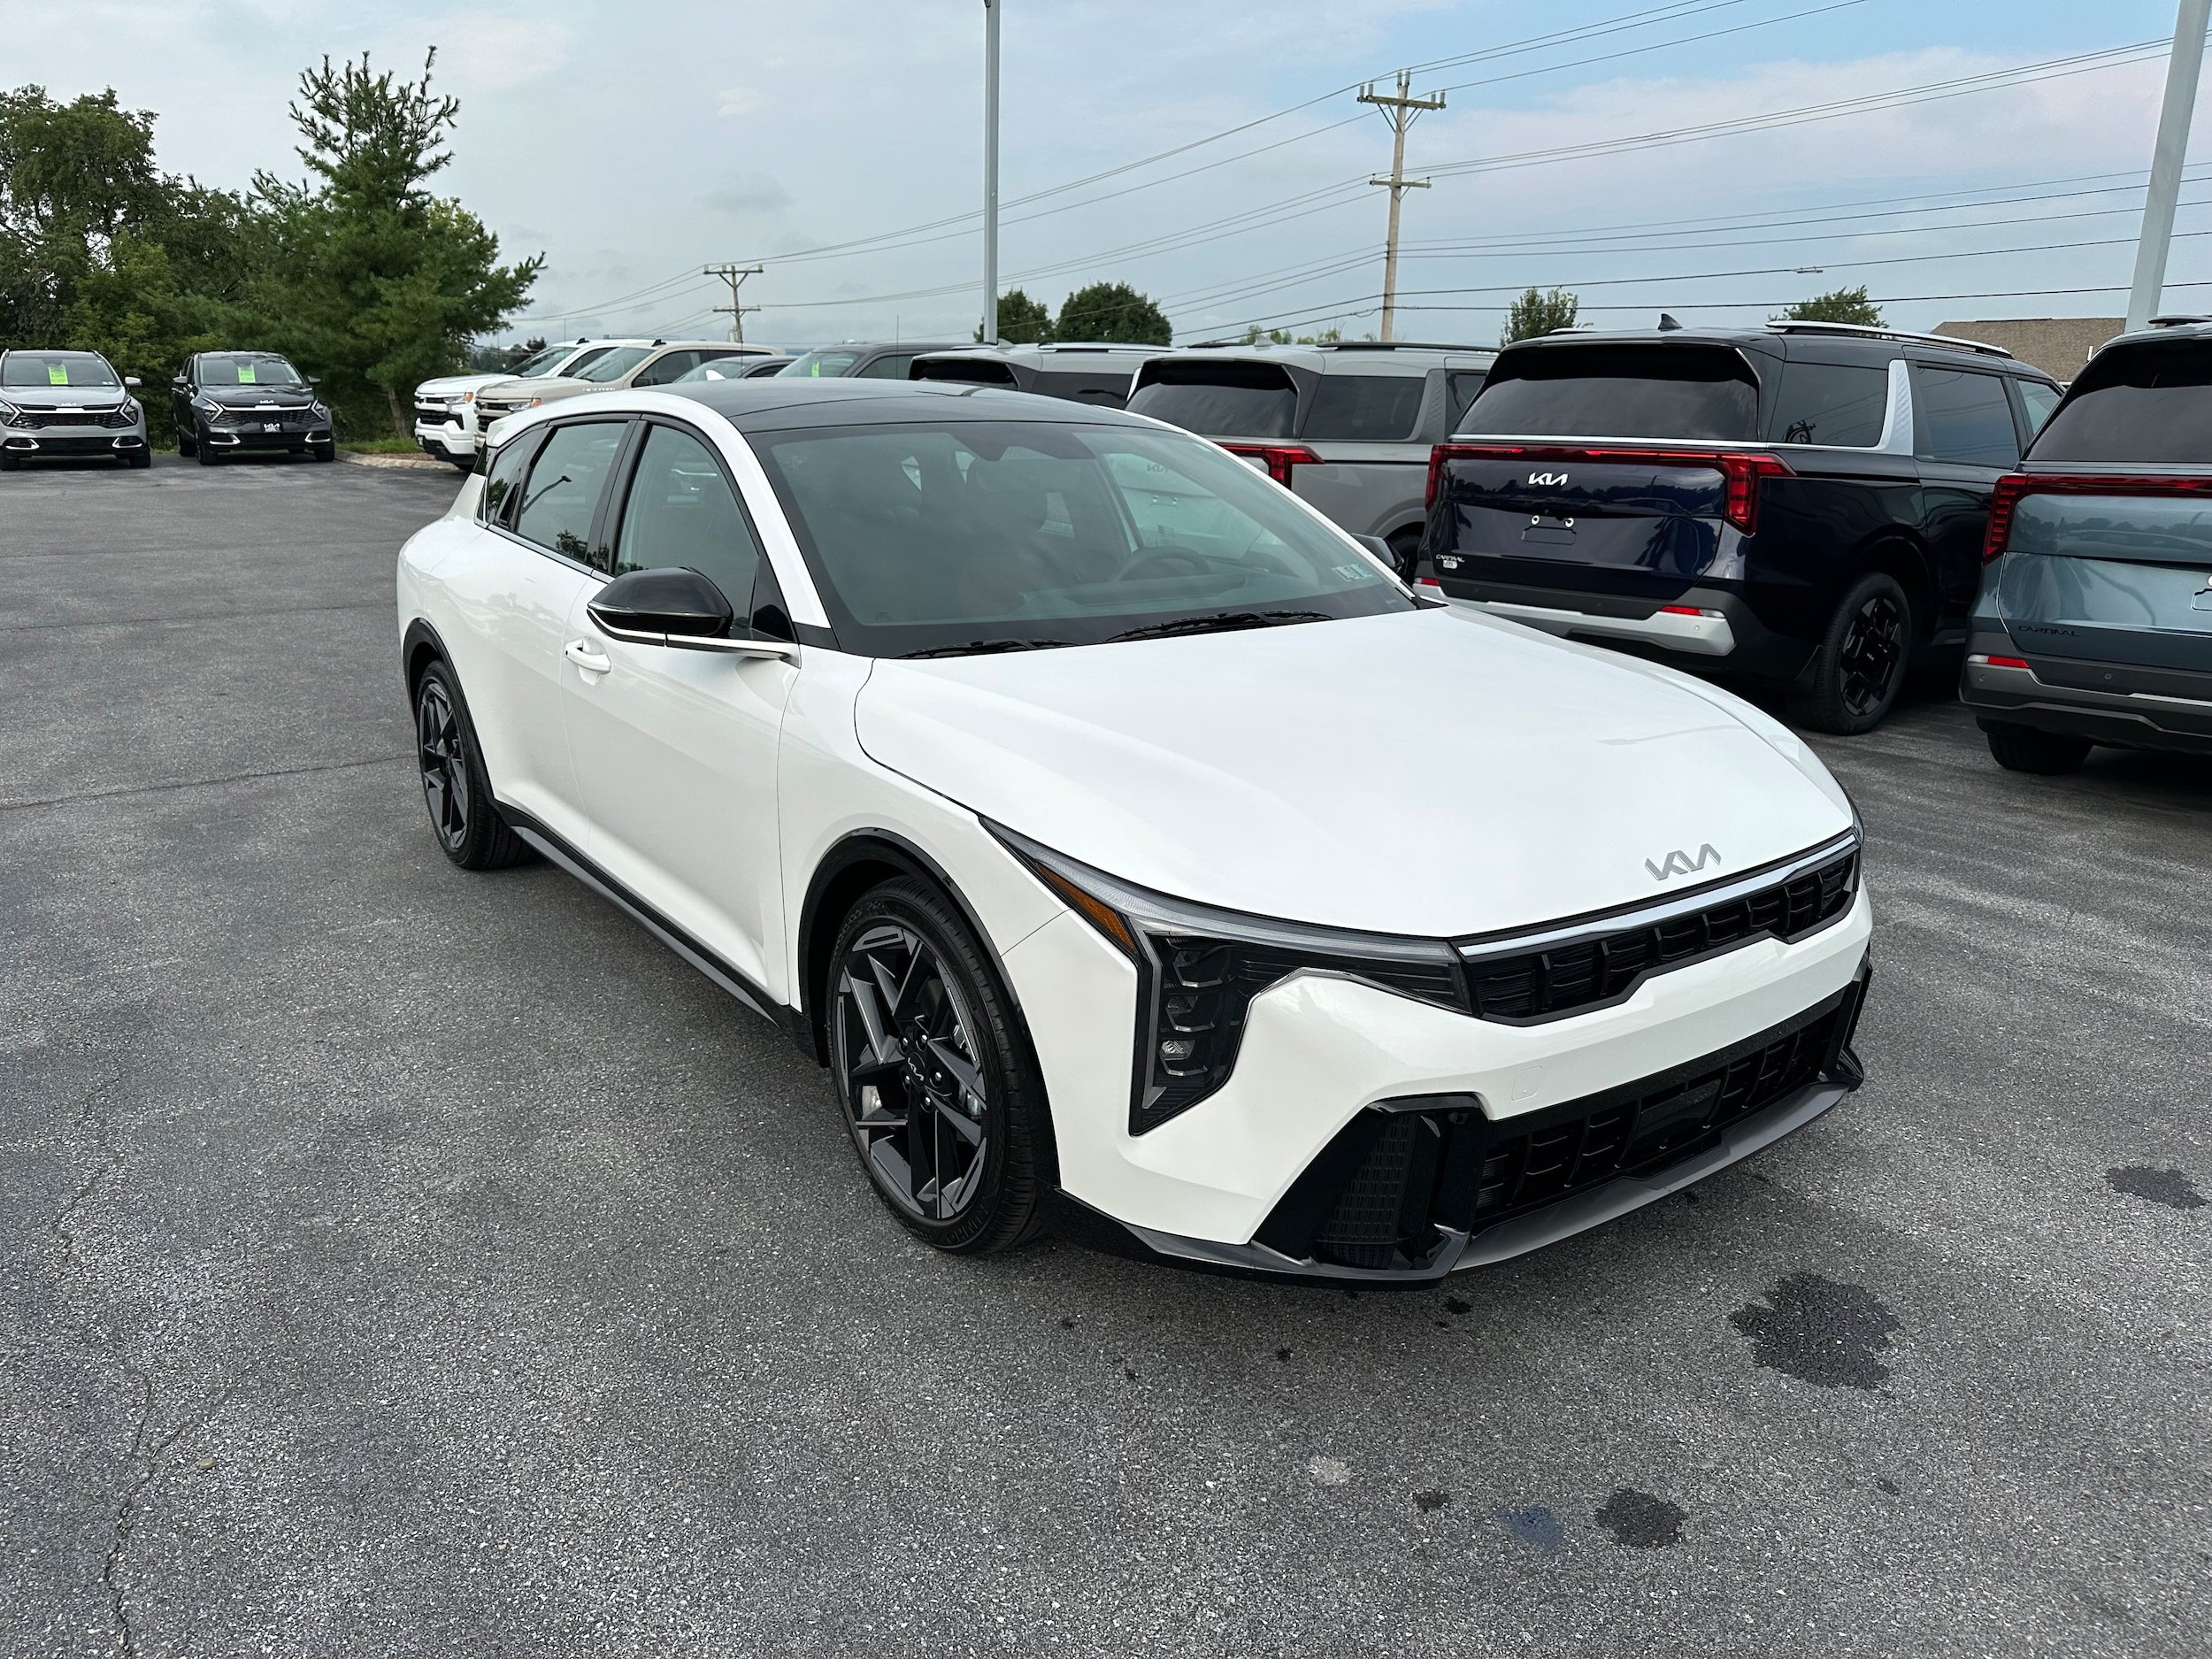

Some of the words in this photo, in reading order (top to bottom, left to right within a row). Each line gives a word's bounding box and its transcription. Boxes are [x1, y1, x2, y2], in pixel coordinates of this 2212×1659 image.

[1528, 472, 1569, 487] KIA
[2018, 626, 2081, 637] CARNIVAL
[1645, 843, 1722, 881] KIA
